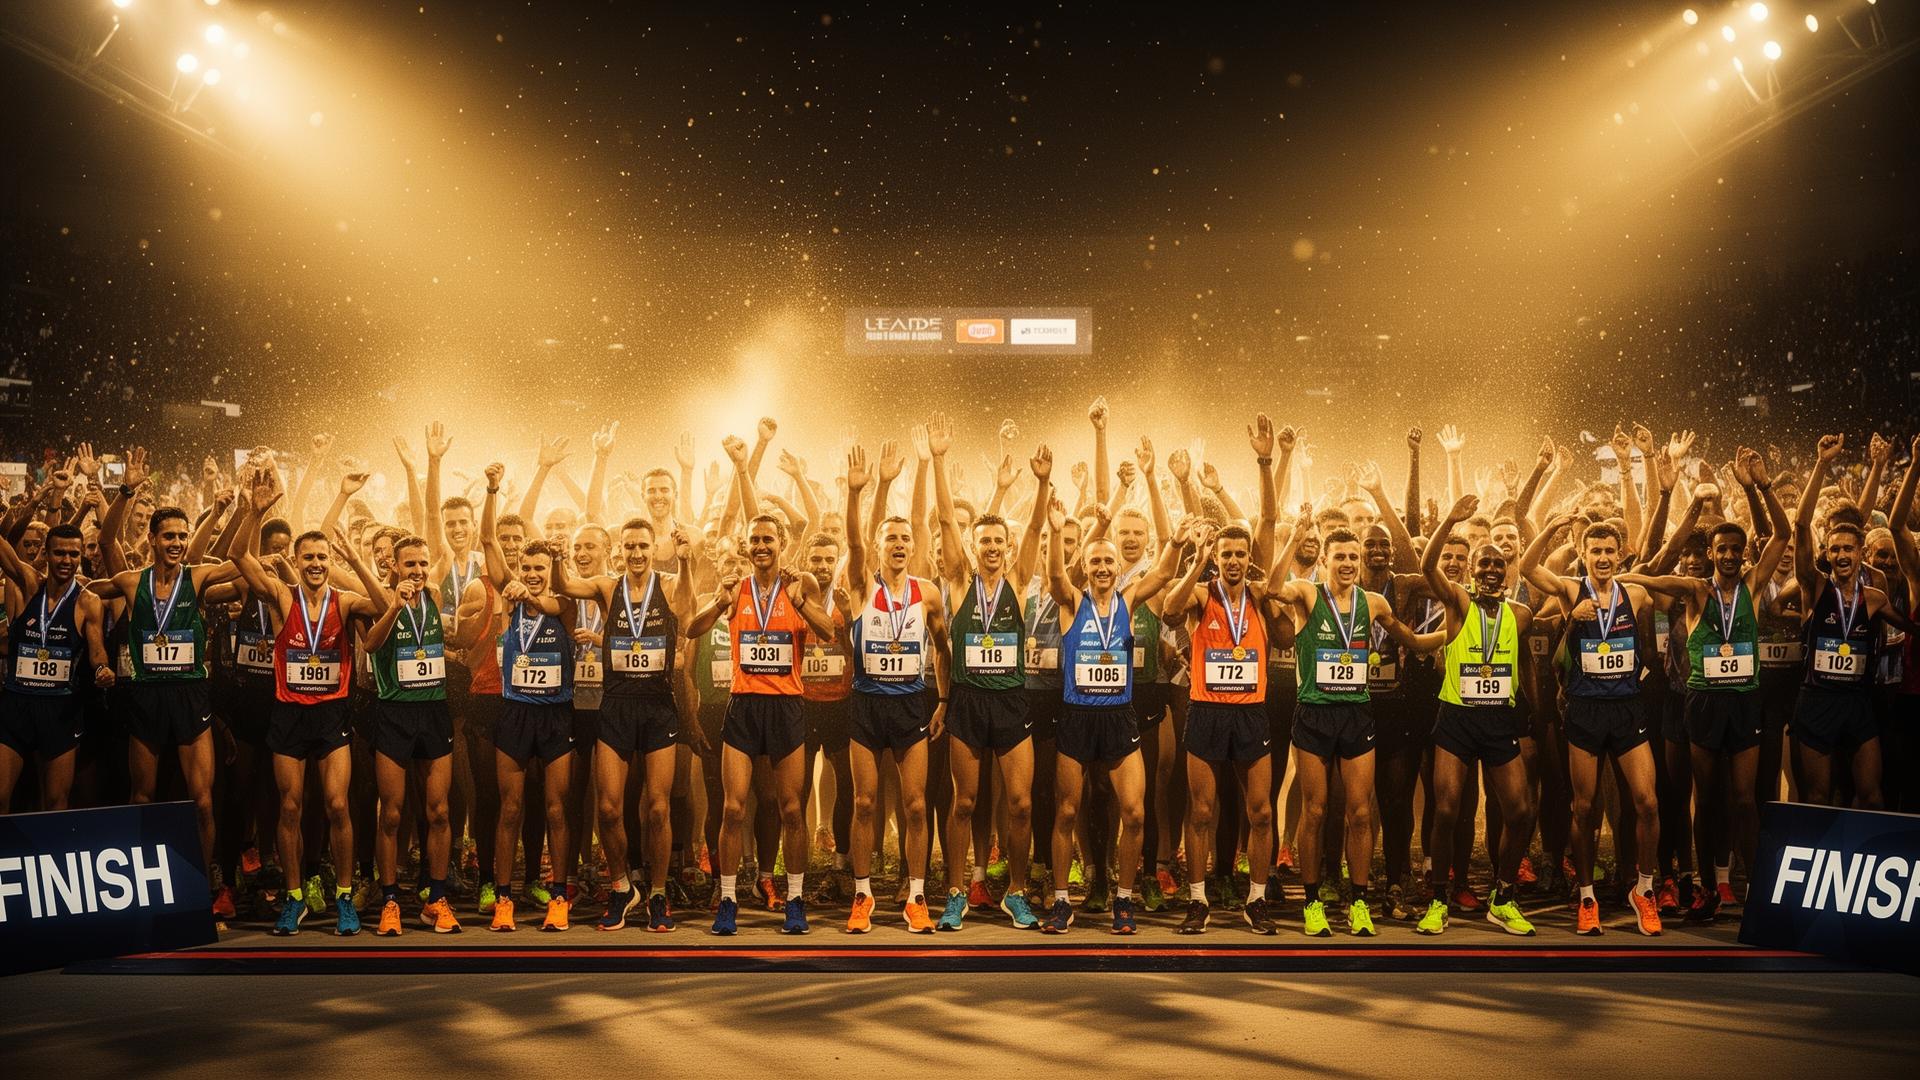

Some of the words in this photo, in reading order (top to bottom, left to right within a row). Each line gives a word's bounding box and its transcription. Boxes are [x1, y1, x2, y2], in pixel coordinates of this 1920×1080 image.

[156, 646, 179, 661] 117
[750, 647, 780, 661] 3031
[980, 649, 1003, 663] 118
[1766, 645, 1788, 659] 107
[879, 657, 903, 671] 911
[1828, 655, 1853, 671] 102
[522, 669, 547, 684] 172
[1217, 665, 1243, 680] 772
[0, 844, 175, 922] FINISH
